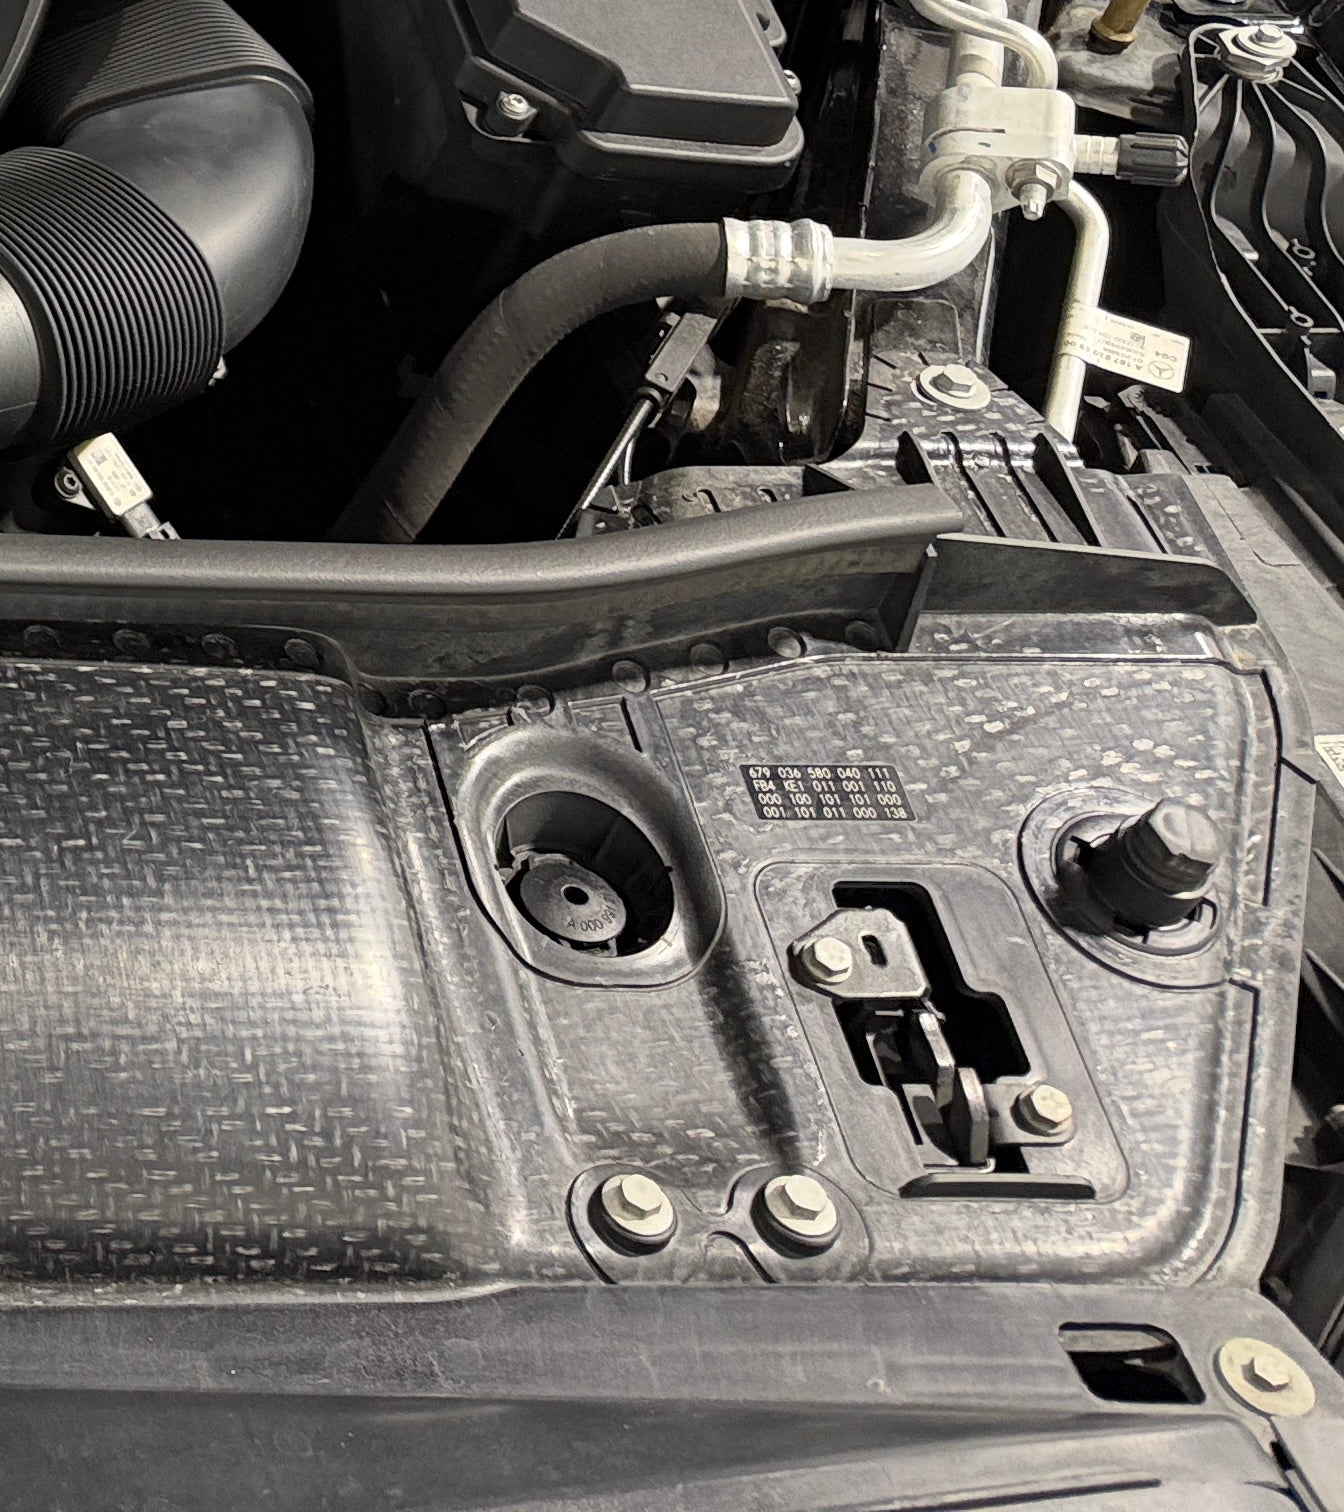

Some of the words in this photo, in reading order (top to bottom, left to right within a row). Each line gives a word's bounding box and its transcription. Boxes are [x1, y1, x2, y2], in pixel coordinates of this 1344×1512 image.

[749, 767, 771, 779] 679
[778, 767, 801, 779] 036
[807, 767, 831, 779] 580
[837, 767, 861, 779] 040
[868, 767, 889, 779] 111
[753, 780, 776, 792] FB4
[783, 780, 804, 792] KE1
[812, 780, 836, 792] 011
[842, 780, 865, 792] 001
[873, 780, 896, 792] 110
[758, 793, 782, 805] 000
[790, 793, 812, 805] 100
[819, 793, 841, 805] 101
[849, 793, 871, 805] 101
[877, 793, 902, 805] 000
[763, 807, 787, 819] 001
[795, 807, 816, 819] 101
[823, 807, 846, 819] 011
[853, 807, 877, 819] 000
[884, 807, 907, 819] 138
[566, 919, 576, 929] A
[580, 918, 604, 932] 000
